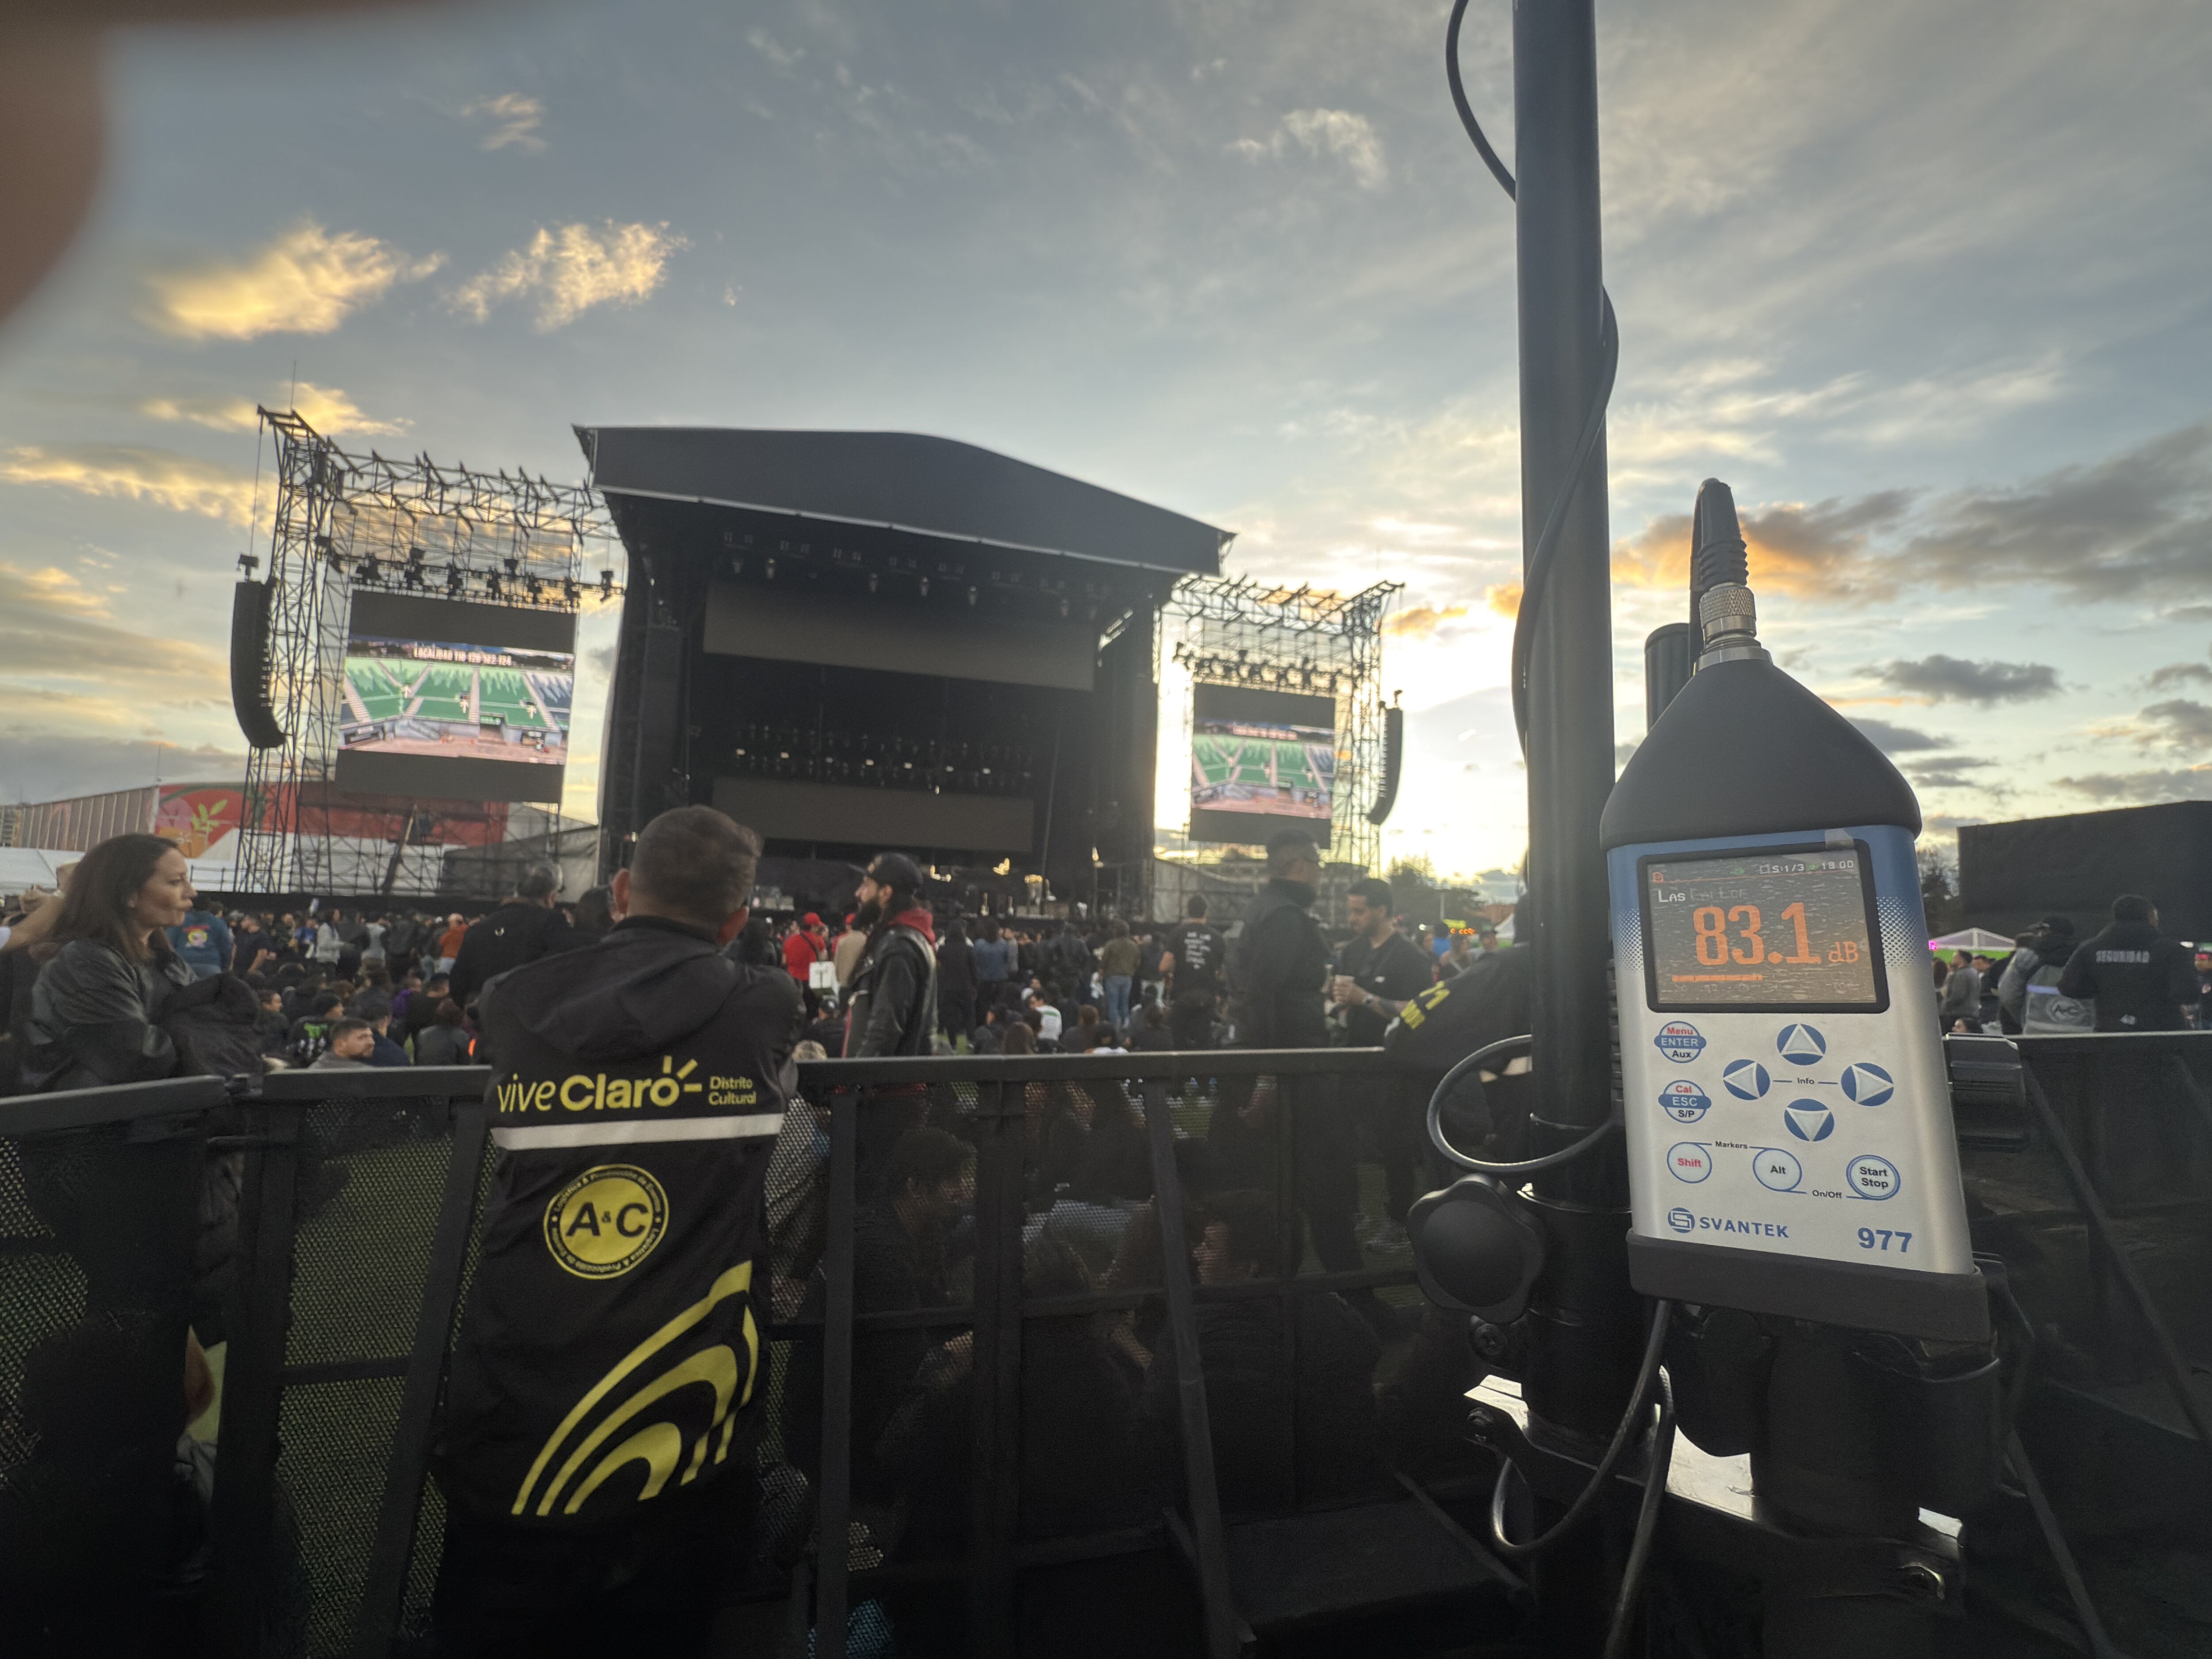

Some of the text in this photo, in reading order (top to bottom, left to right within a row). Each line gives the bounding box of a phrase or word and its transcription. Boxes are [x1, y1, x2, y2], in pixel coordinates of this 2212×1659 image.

[1693, 902, 1859, 966] 83.1 dB
[1667, 1026, 1694, 1035] Menu
[1661, 1037, 1699, 1047] ENTER
[710, 1075, 753, 1090] Distrito
[1797, 1077, 1815, 1086] Info
[497, 1073, 680, 1113] vive Claro
[708, 1091, 757, 1106] Cultural
[1673, 1097, 1698, 1106] ESC
[1715, 1141, 1748, 1150] Markers
[1677, 1158, 1703, 1168] Shift
[1770, 1165, 1787, 1175] Alt
[1859, 1166, 1888, 1177] Start
[1861, 1178, 1889, 1190] Stop
[1812, 1190, 1843, 1199] On/Off
[1699, 1217, 1790, 1239] SVANTEK
[1858, 1228, 1912, 1253] 977
